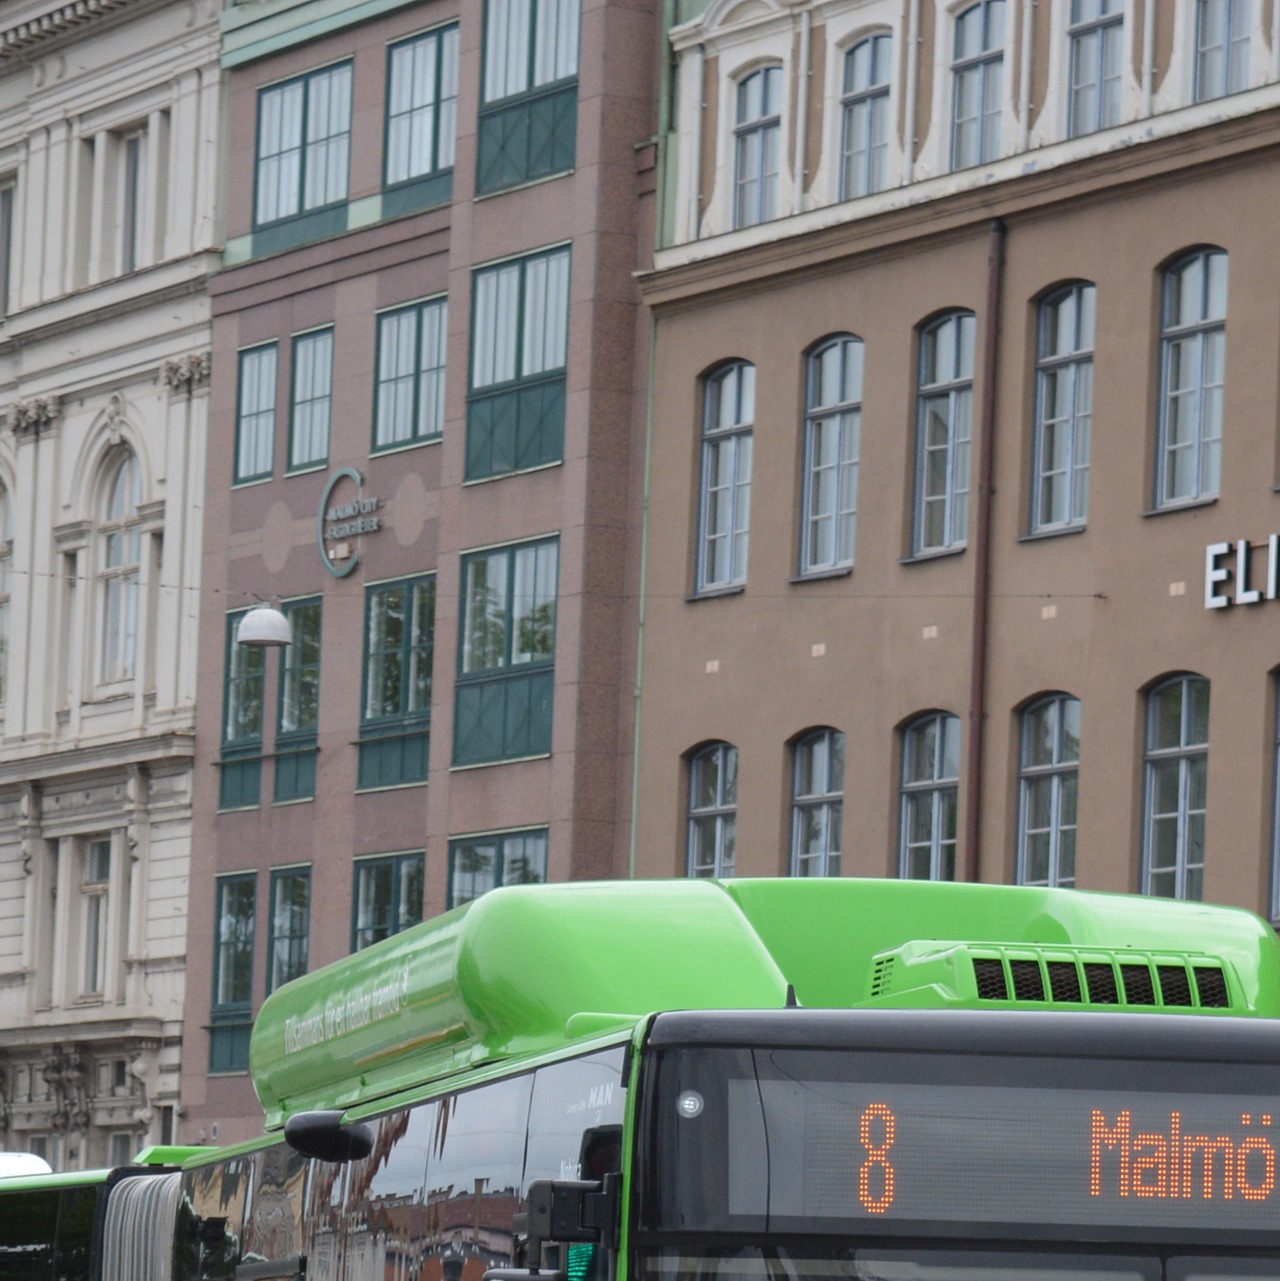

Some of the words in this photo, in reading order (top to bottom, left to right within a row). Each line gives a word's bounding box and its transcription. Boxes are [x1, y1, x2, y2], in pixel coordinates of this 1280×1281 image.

[588, 1082, 614, 1109] MAN
[857, 1101, 897, 1214] 8
[1089, 1109, 1277, 1203] Malmö
